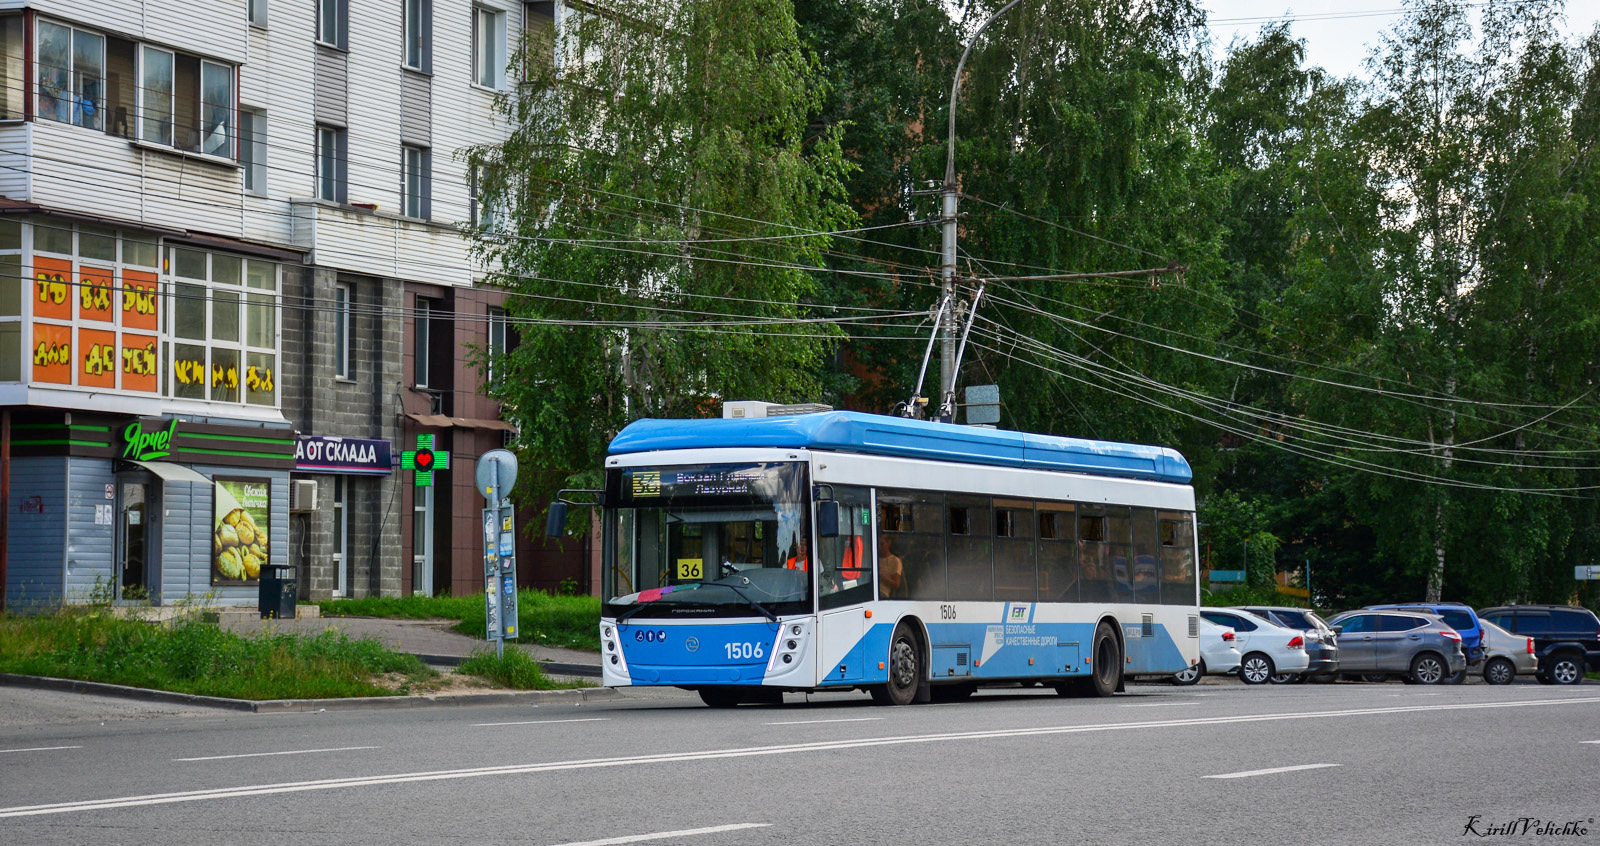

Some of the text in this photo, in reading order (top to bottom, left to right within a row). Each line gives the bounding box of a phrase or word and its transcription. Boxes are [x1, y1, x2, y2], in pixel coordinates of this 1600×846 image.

[122, 418, 178, 461] Ярче!
[306, 440, 324, 461] ОТ
[325, 441, 377, 463] СКЛАДА
[681, 563, 700, 578] 36
[939, 604, 957, 620] 1506
[1005, 624, 1036, 635] БЕЗОПАСНЫЕ
[1005, 636, 1040, 646] КАЧЕСТВЕННЫЕ
[1040, 636, 1058, 648] ДОРОГИ
[724, 641, 764, 660] 1506
